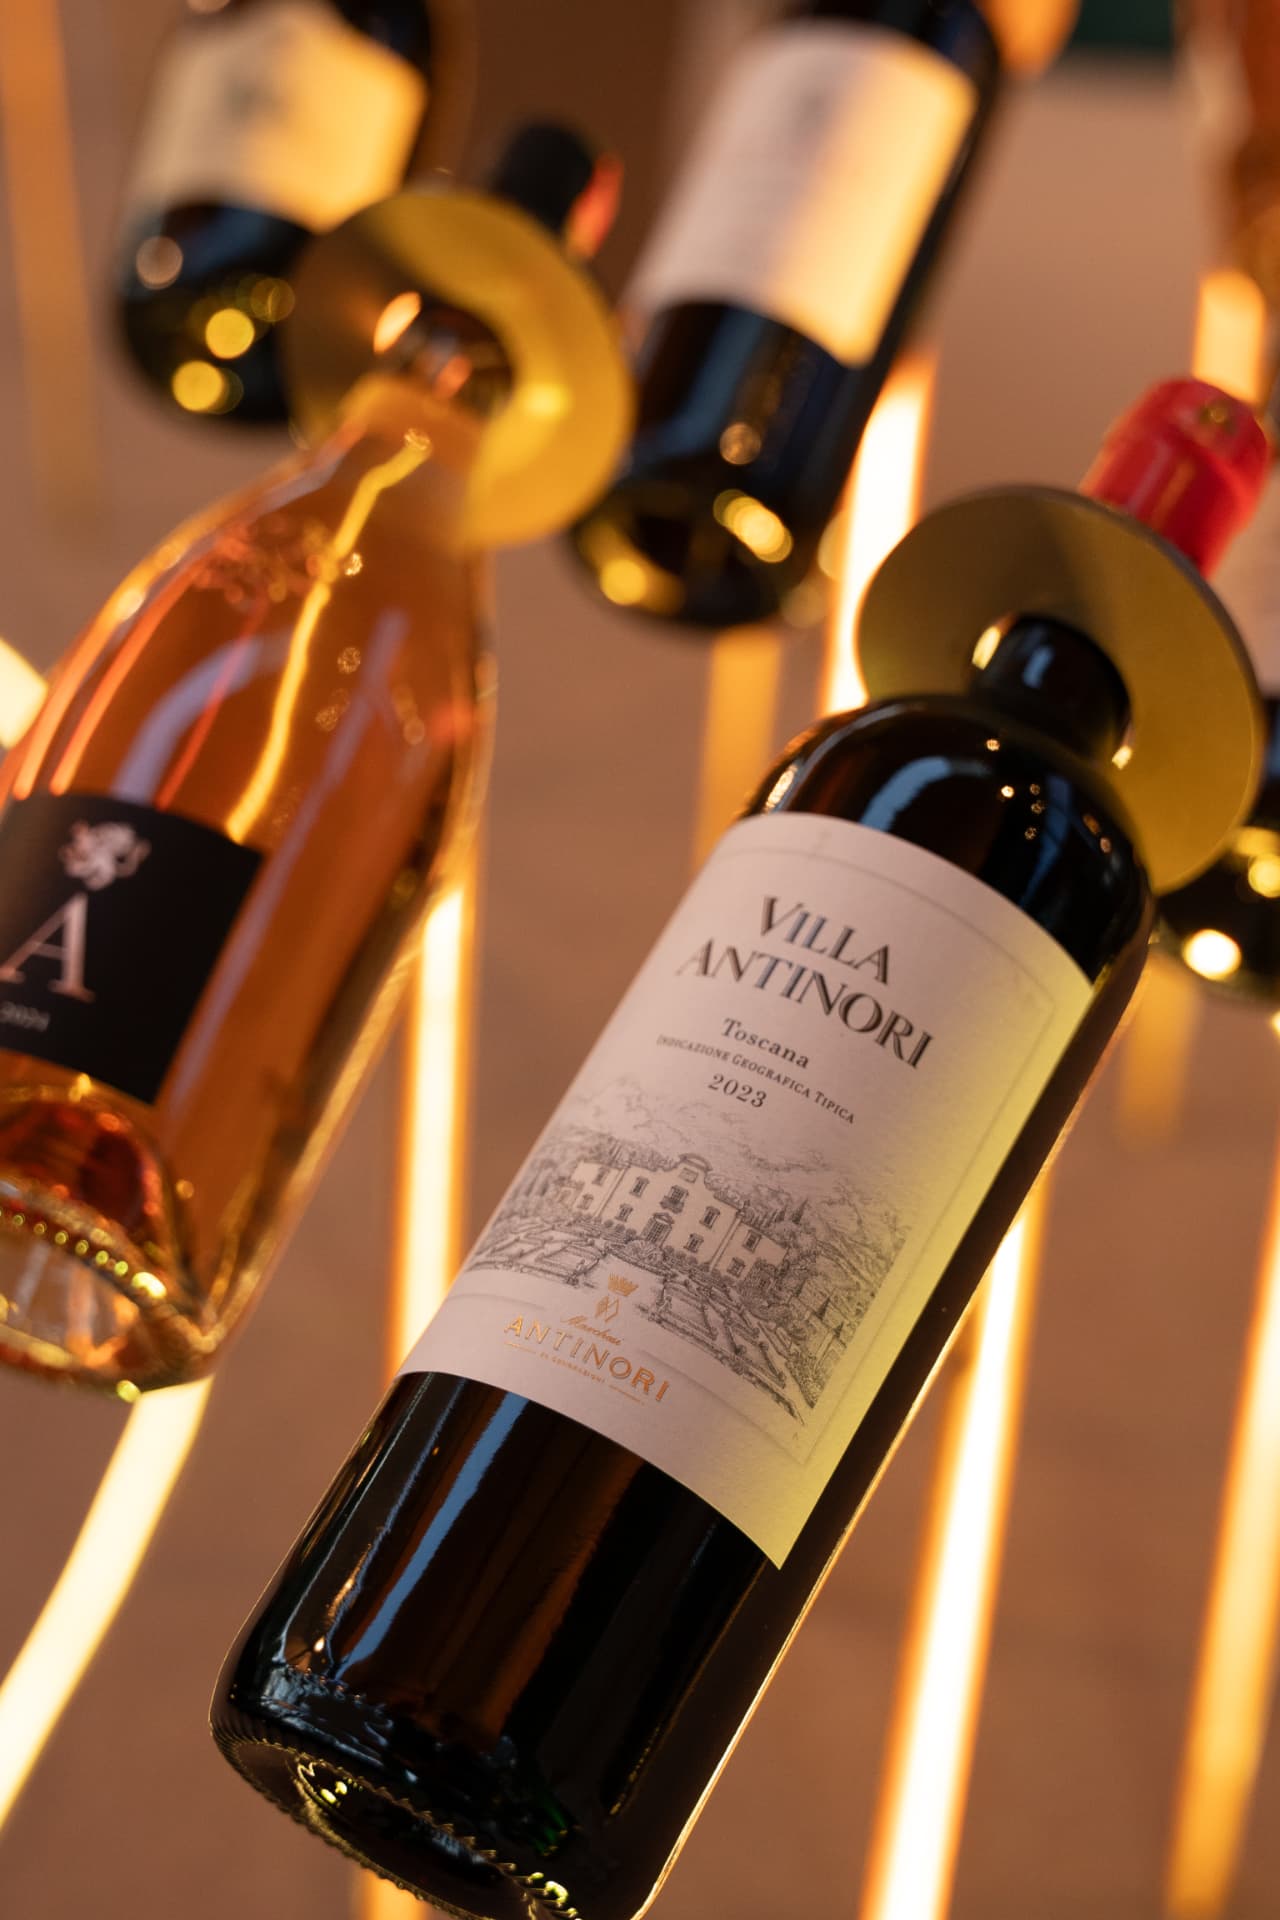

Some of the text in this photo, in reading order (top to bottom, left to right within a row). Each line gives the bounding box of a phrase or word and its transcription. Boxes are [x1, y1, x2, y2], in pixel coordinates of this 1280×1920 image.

[0, 892, 96, 1002] A
[759, 895, 891, 987] VILLA
[676, 938, 934, 1069] ANTINORI
[721, 1017, 810, 1069] Toscana
[708, 1073, 768, 1108] 2023
[504, 1315, 670, 1402] ANTINORI
